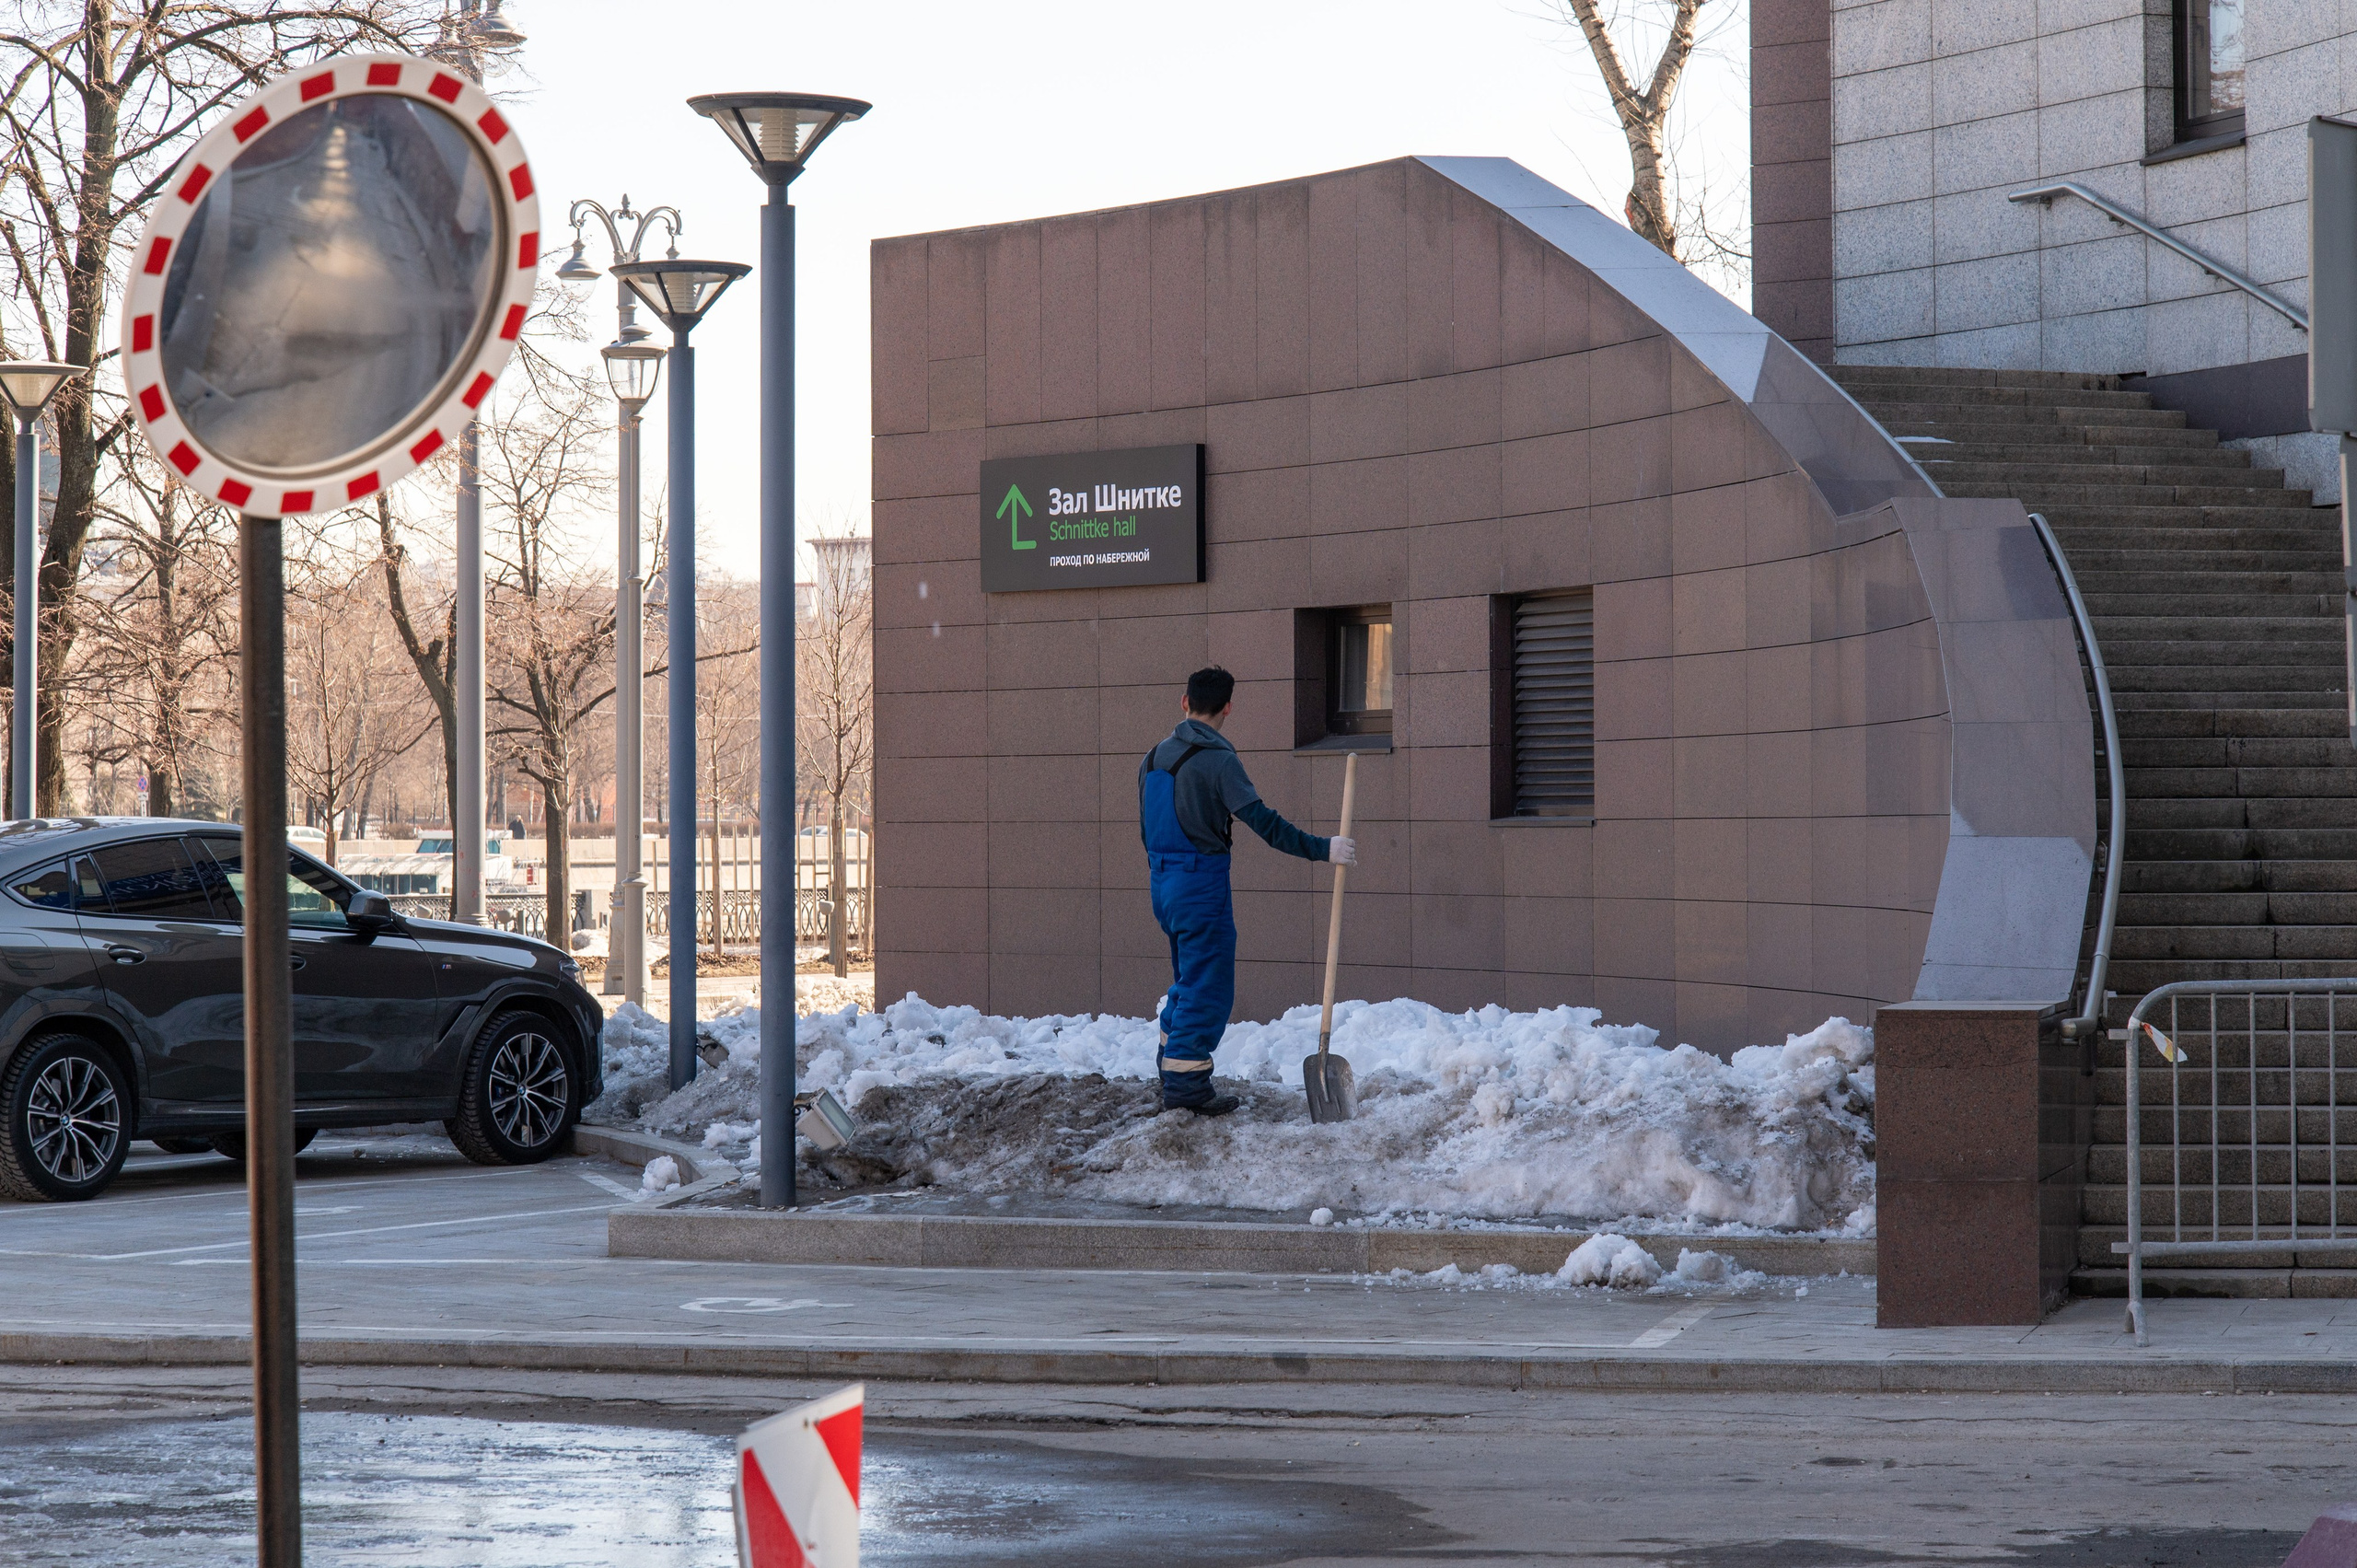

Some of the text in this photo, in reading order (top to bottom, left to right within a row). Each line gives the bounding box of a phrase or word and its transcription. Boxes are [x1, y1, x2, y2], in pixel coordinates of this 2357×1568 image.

[1049, 483, 1182, 516] Зал Шнитке
[1050, 516, 1136, 541] Schnittke hall
[1050, 548, 1150, 567] ПРОХОД ПО НАБЕРЕЖНОЙ
